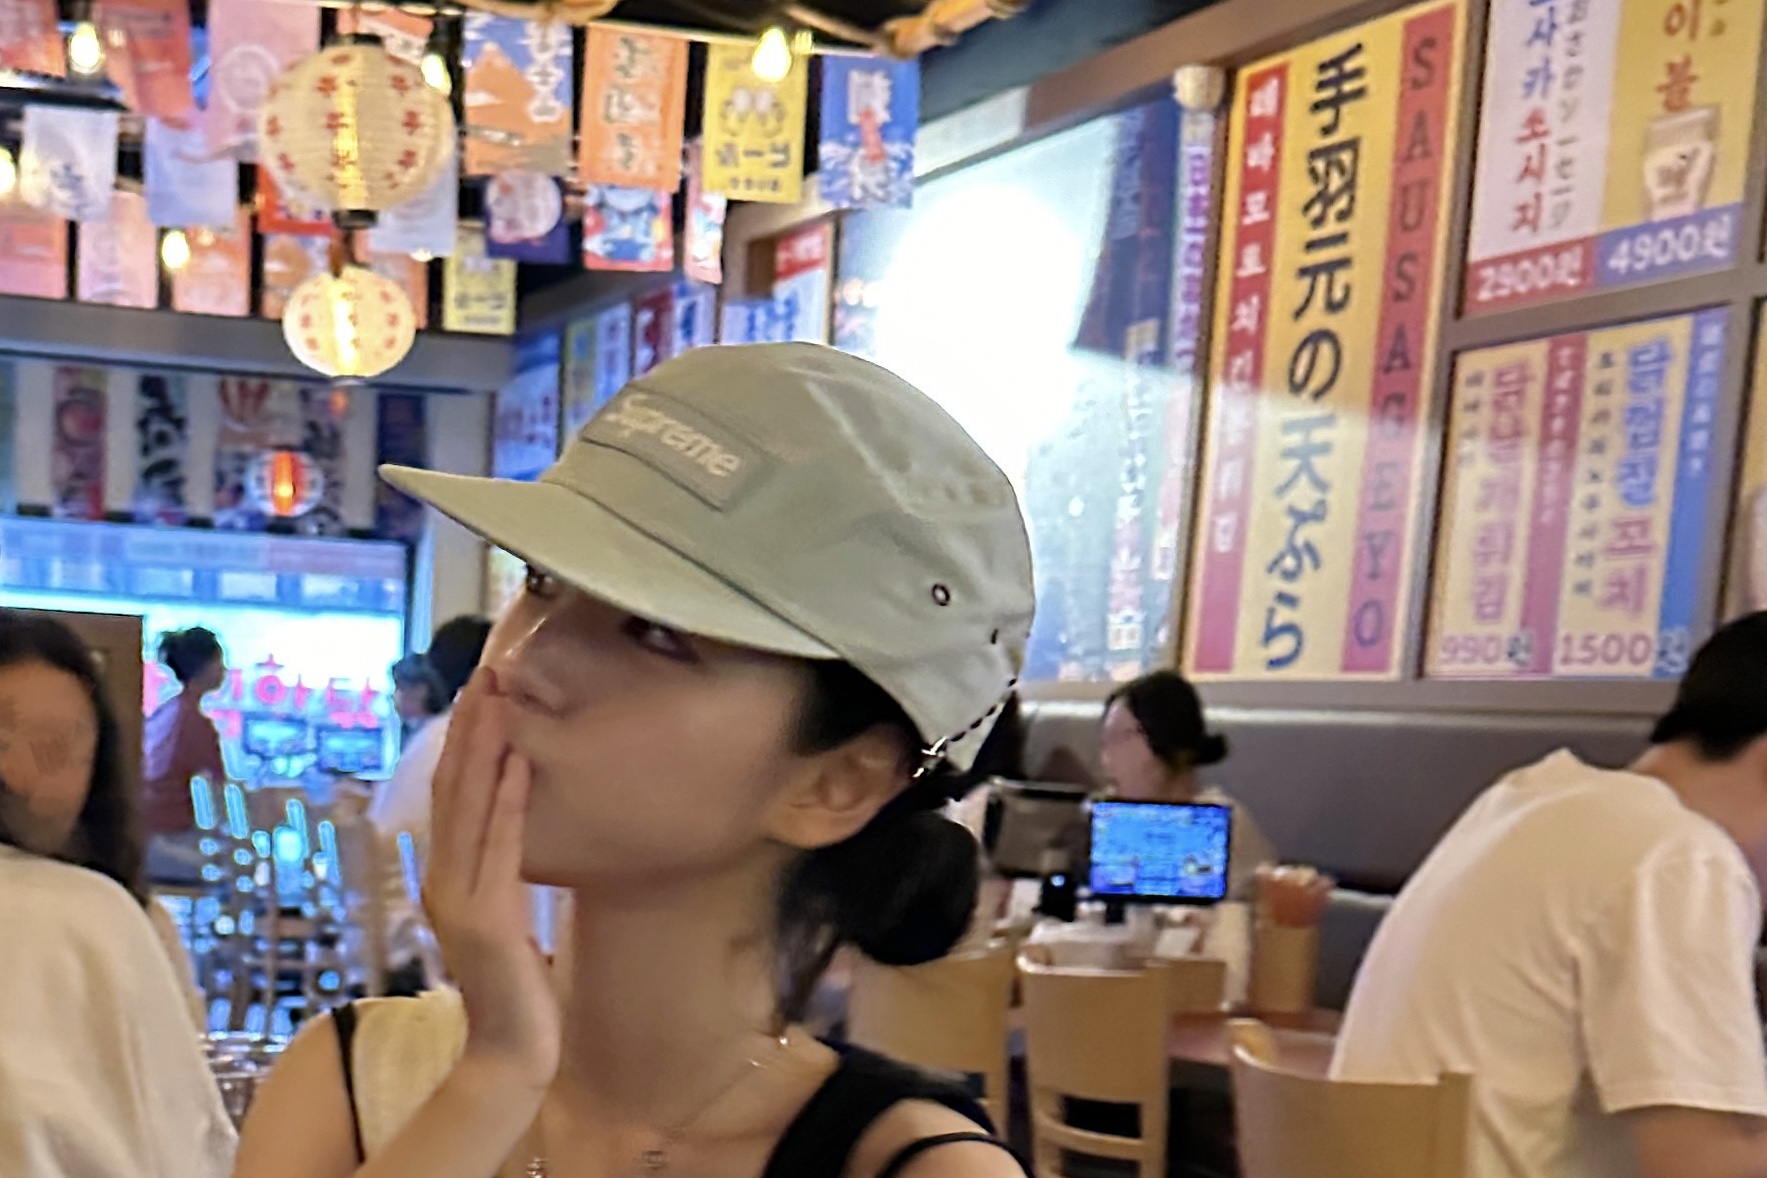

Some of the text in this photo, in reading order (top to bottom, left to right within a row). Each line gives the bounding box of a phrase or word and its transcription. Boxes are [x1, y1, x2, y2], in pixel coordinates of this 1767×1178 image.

[1511, 104, 1551, 233] 소시지
[1476, 242, 1585, 302] 2900원
[1607, 213, 1733, 276] 4900원
[1261, 42, 1367, 672] 手羽元の天ぷら
